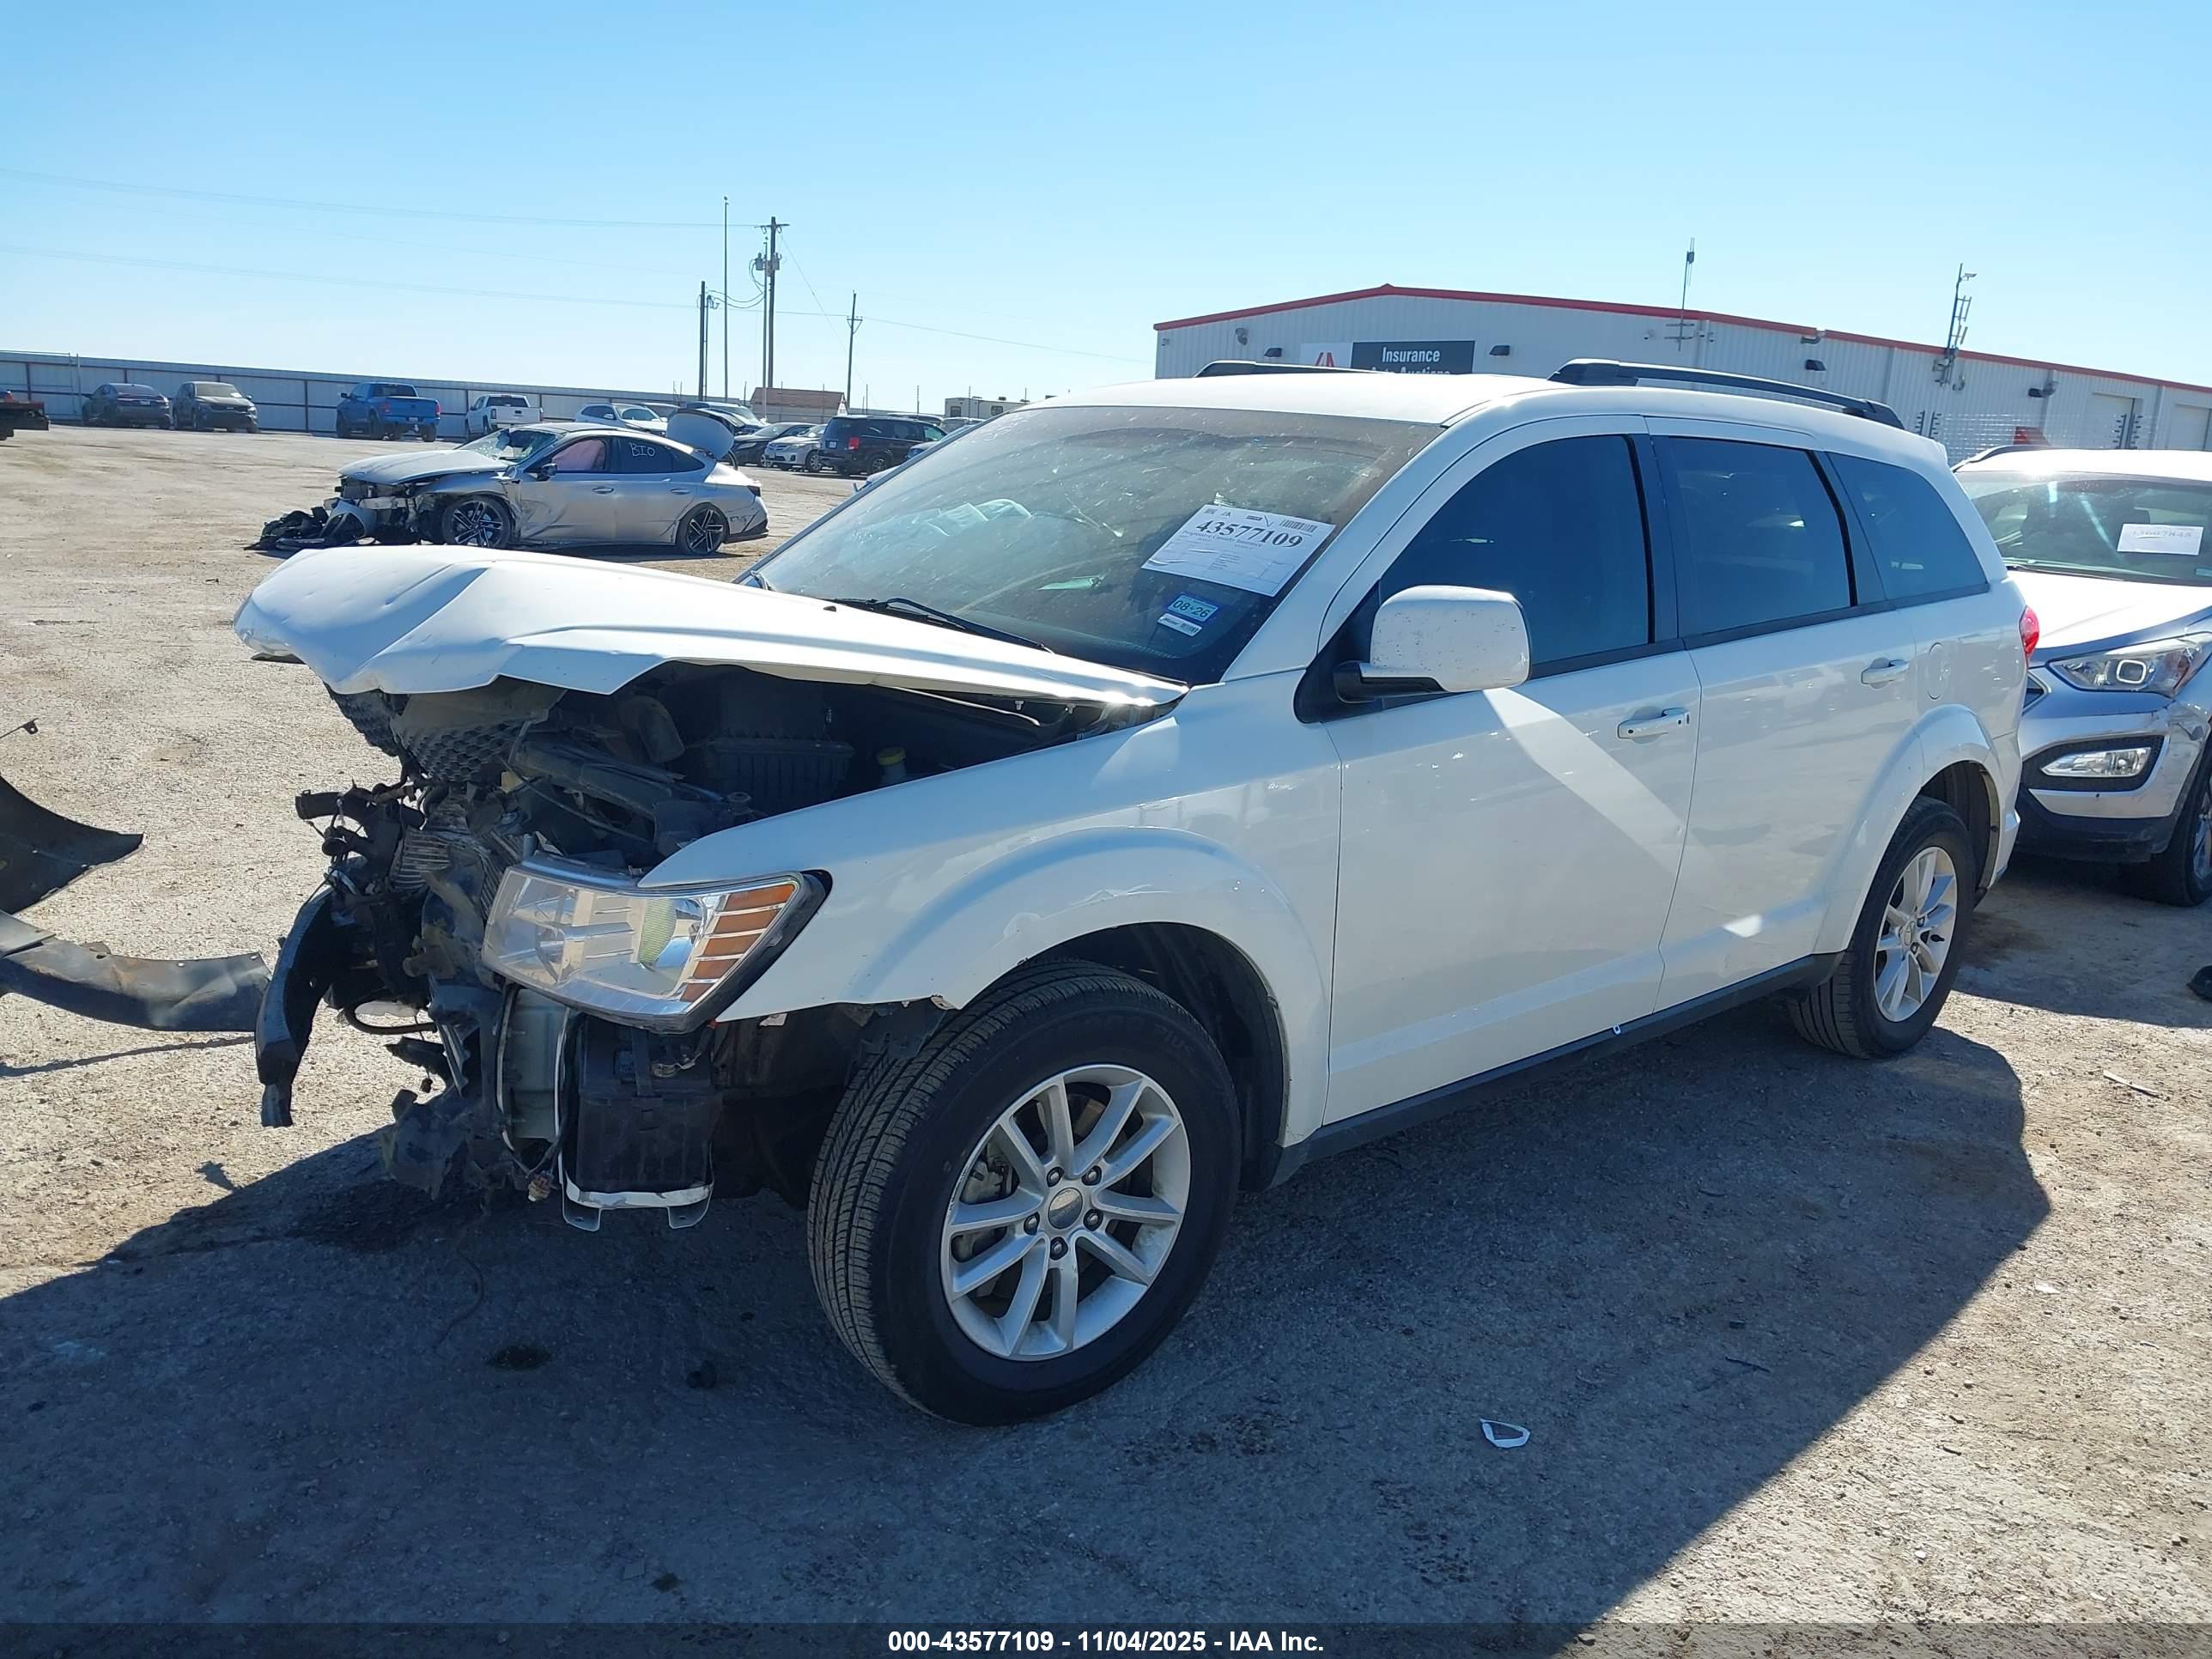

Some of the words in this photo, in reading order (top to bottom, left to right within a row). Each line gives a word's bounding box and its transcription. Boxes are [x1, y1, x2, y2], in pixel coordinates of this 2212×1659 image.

[1382, 346, 1441, 363] Insurance
[629, 441, 656, 457] BIO
[1196, 520, 1304, 548] 43577109
